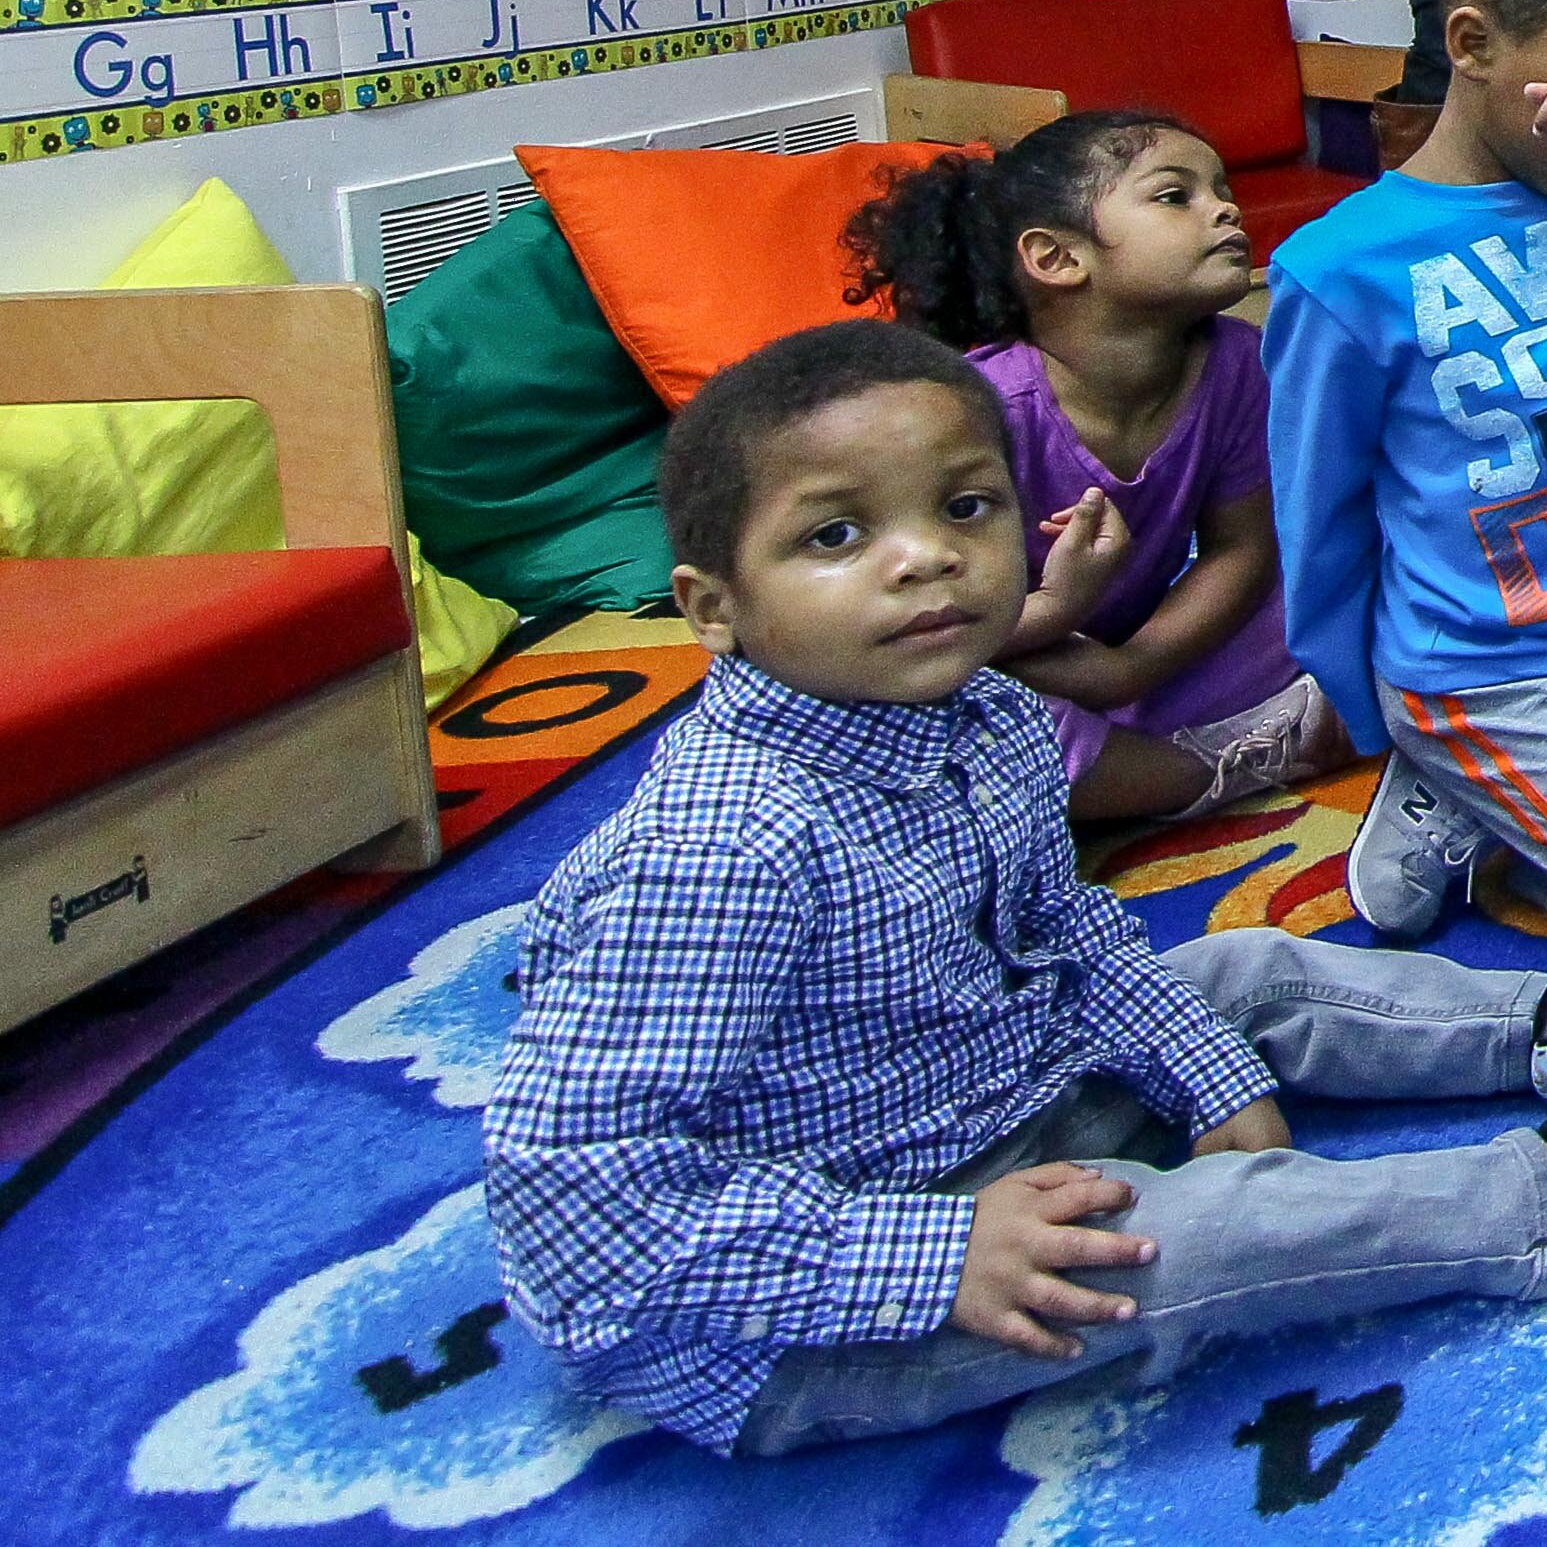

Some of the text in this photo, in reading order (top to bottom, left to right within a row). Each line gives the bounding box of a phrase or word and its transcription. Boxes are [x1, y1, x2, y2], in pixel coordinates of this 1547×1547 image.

[73, 30, 177, 109] Gg
[233, 13, 313, 81] Hh
[370, 1, 415, 63] Ii
[1233, 1383, 1406, 1520] 4
